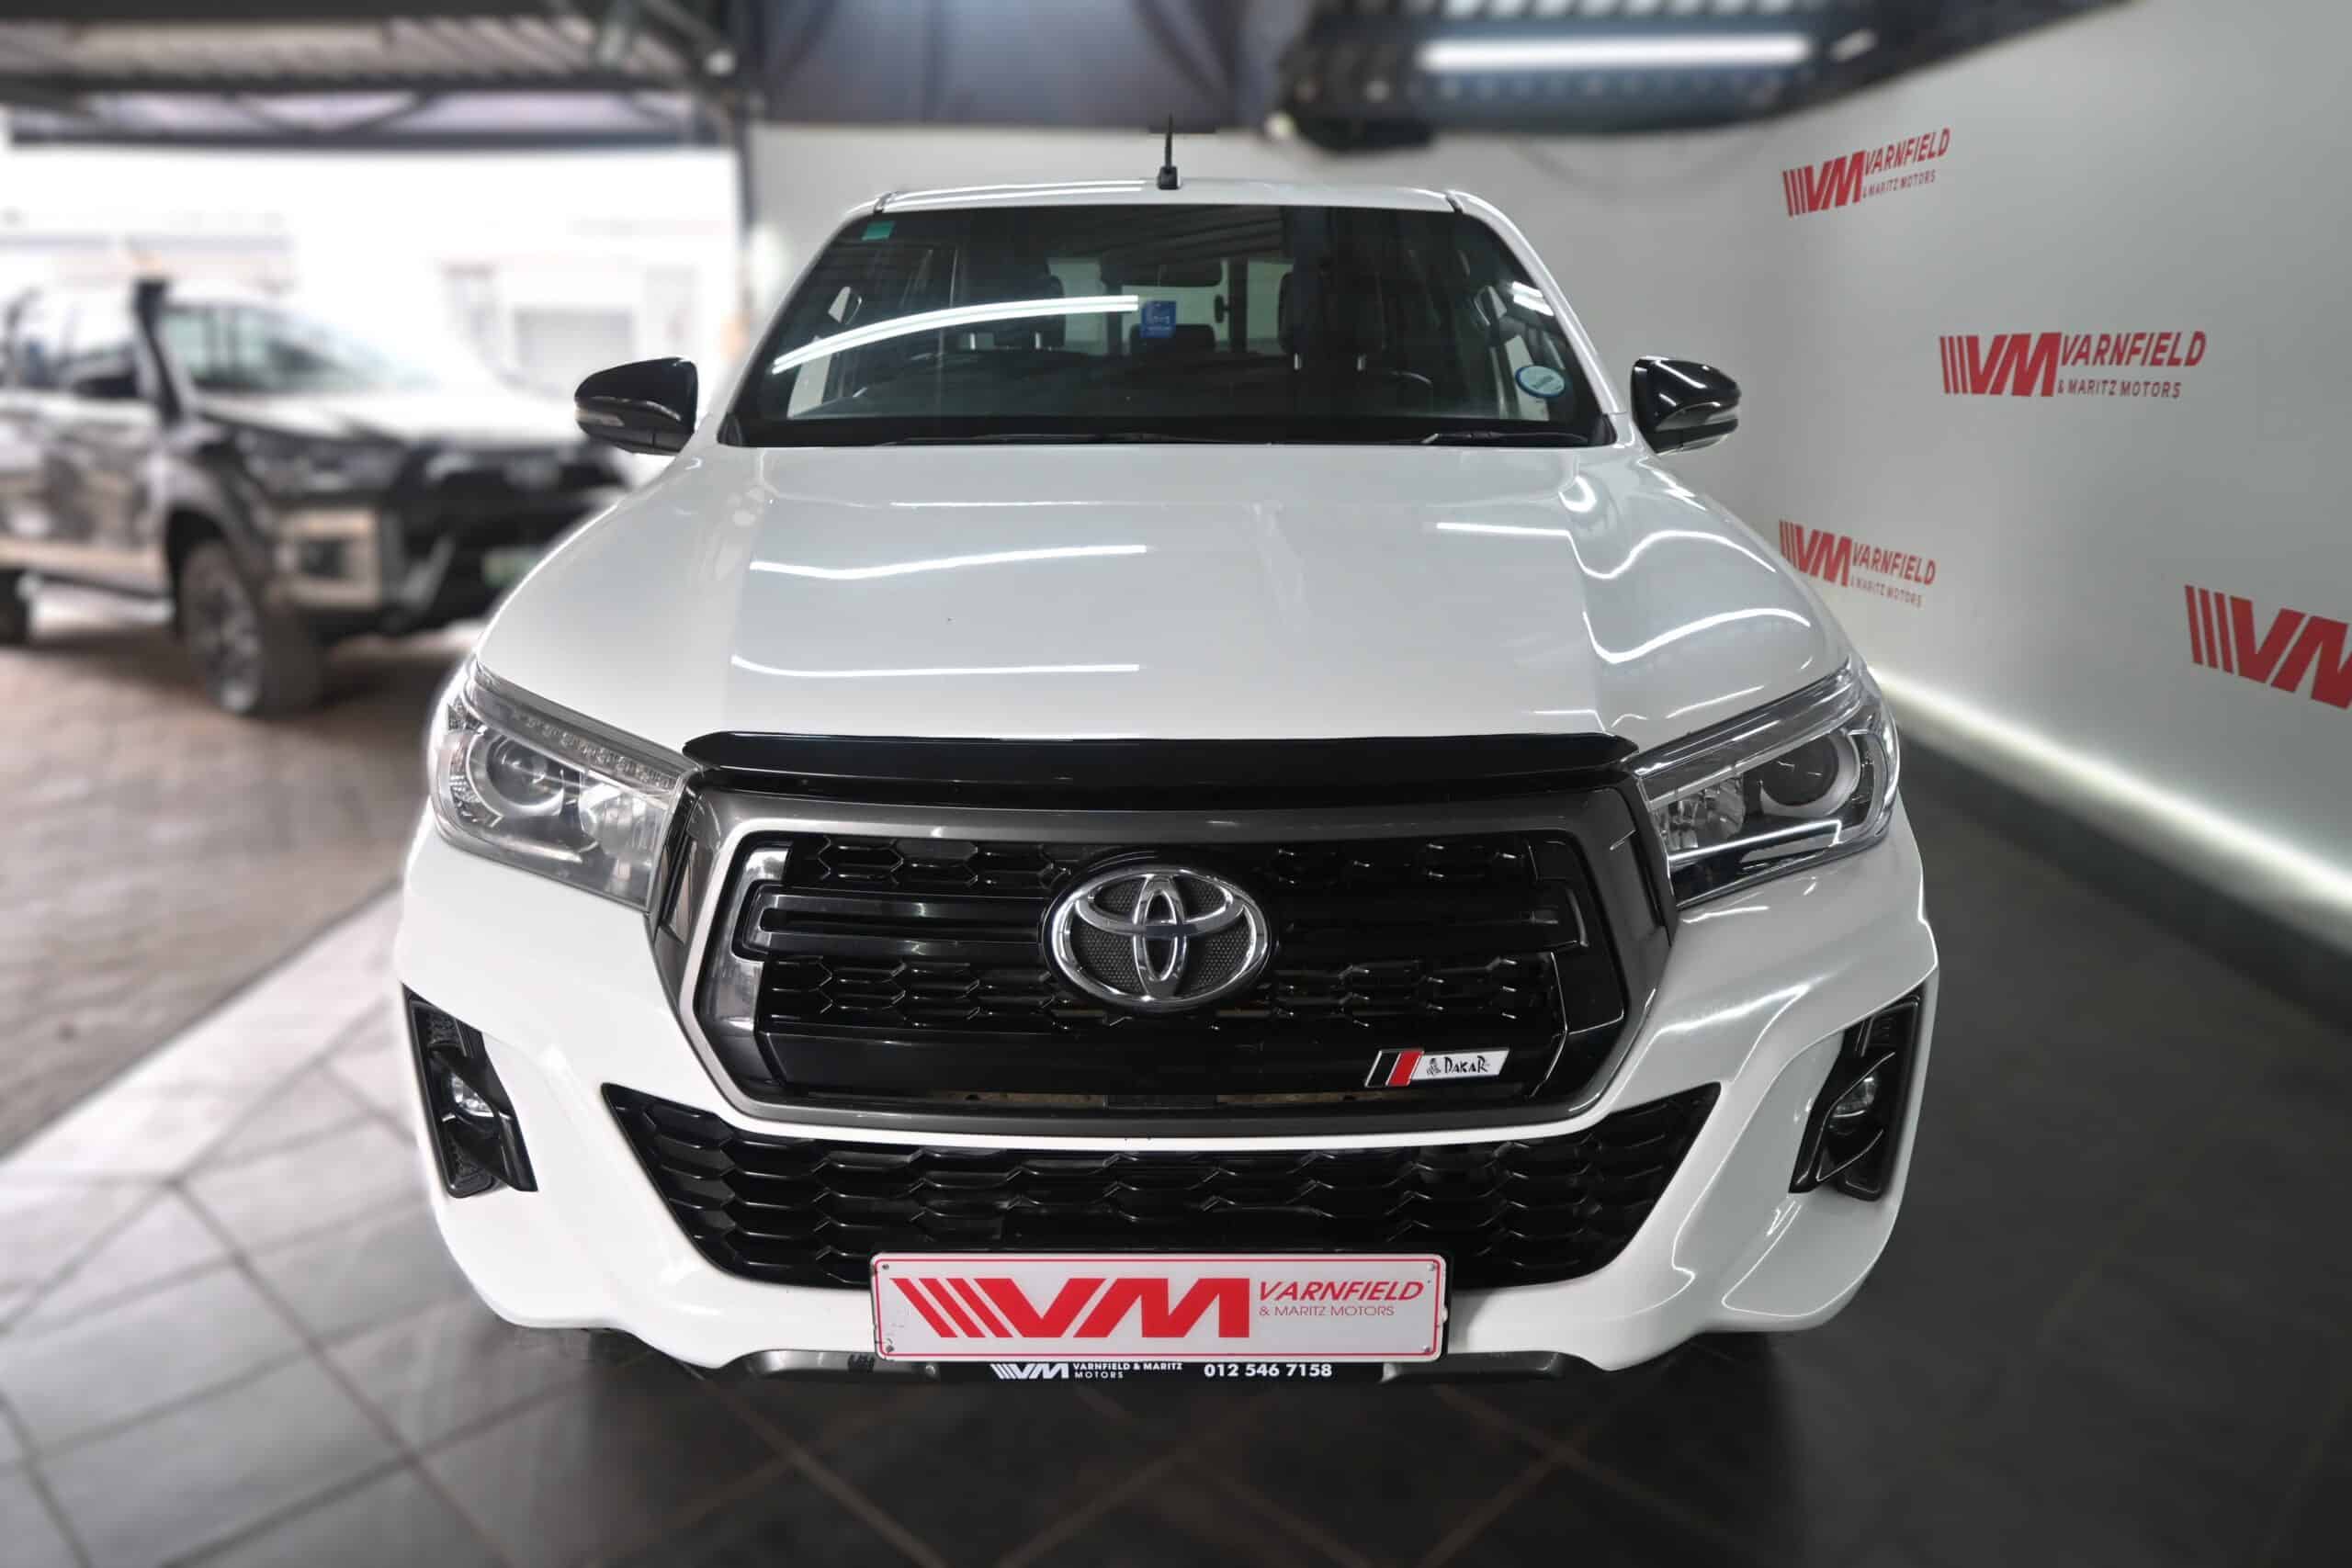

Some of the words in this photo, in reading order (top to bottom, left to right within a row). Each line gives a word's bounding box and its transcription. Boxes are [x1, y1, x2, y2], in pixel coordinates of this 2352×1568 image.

[1865, 128, 1951, 176] VARNFIELD
[1804, 150, 1867, 212] VM
[1869, 177, 1899, 197] MARITZ
[1900, 169, 1937, 190] MOTORS
[2061, 331, 2207, 367] VARNFIELD
[1966, 332, 2062, 397] VM
[2068, 379, 2118, 396] MARITZ
[2120, 381, 2182, 399] MOTORS
[1795, 524, 1853, 588] VM
[1852, 542, 1937, 585] VARNFIELD
[1443, 1055, 1488, 1074] DAKAR
[1259, 1280, 1424, 1301] VARNFIELD
[974, 1278, 1250, 1338] VM
[1259, 1305, 1270, 1316] &
[1274, 1305, 1326, 1316] MARITZ
[1330, 1305, 1395, 1316] MOTORS
[1008, 1363, 1069, 1379] VM
[1073, 1362, 1131, 1371] VARNFIELD
[1143, 1362, 1183, 1371] MARITZ
[1074, 1371, 1124, 1379] MOTORS
[1204, 1363, 1239, 1377] 012
[1245, 1363, 1280, 1377] 546
[1286, 1363, 1332, 1377] 7158
